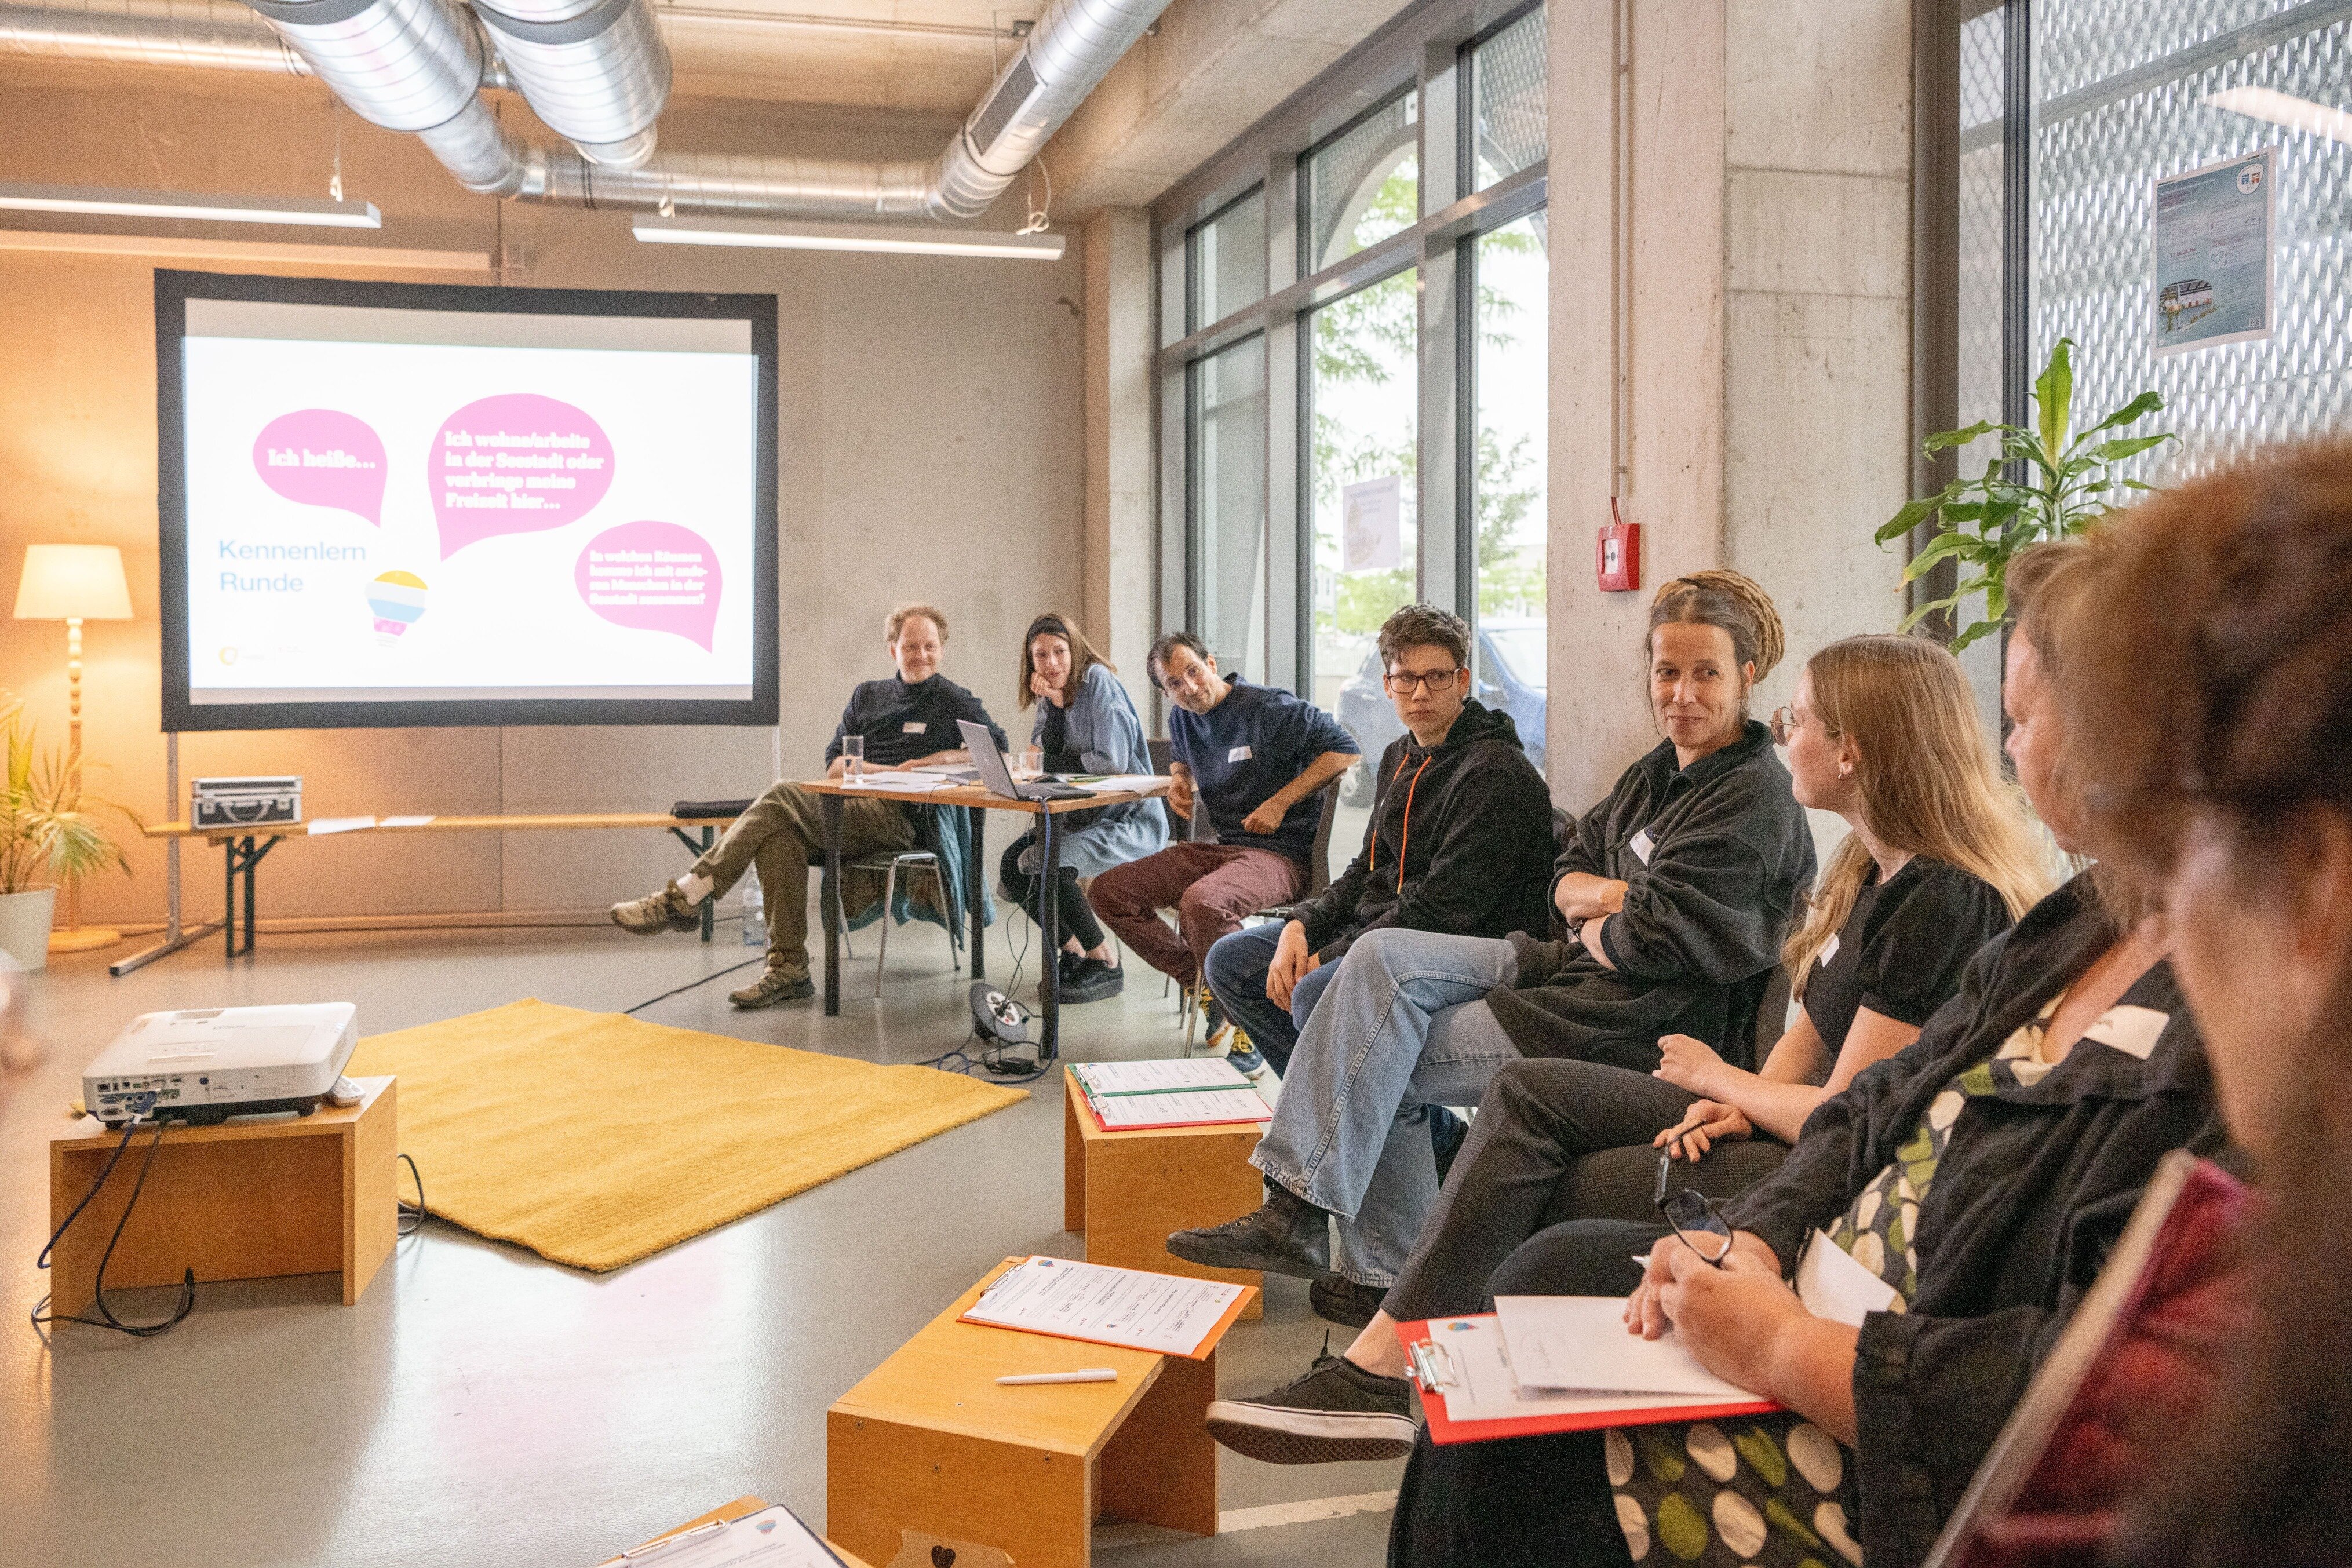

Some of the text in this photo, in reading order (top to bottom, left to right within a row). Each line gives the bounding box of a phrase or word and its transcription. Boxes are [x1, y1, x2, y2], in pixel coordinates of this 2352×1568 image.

[445, 429, 473, 447] Ich
[267, 448, 300, 467] Ich
[465, 451, 494, 468] der
[495, 452, 565, 469] Seestadt
[566, 453, 604, 469] oder
[445, 471, 577, 492] verbringe meine
[445, 492, 509, 509] Freizeit
[218, 539, 366, 561] Kennenlern
[219, 571, 304, 592] Runde
